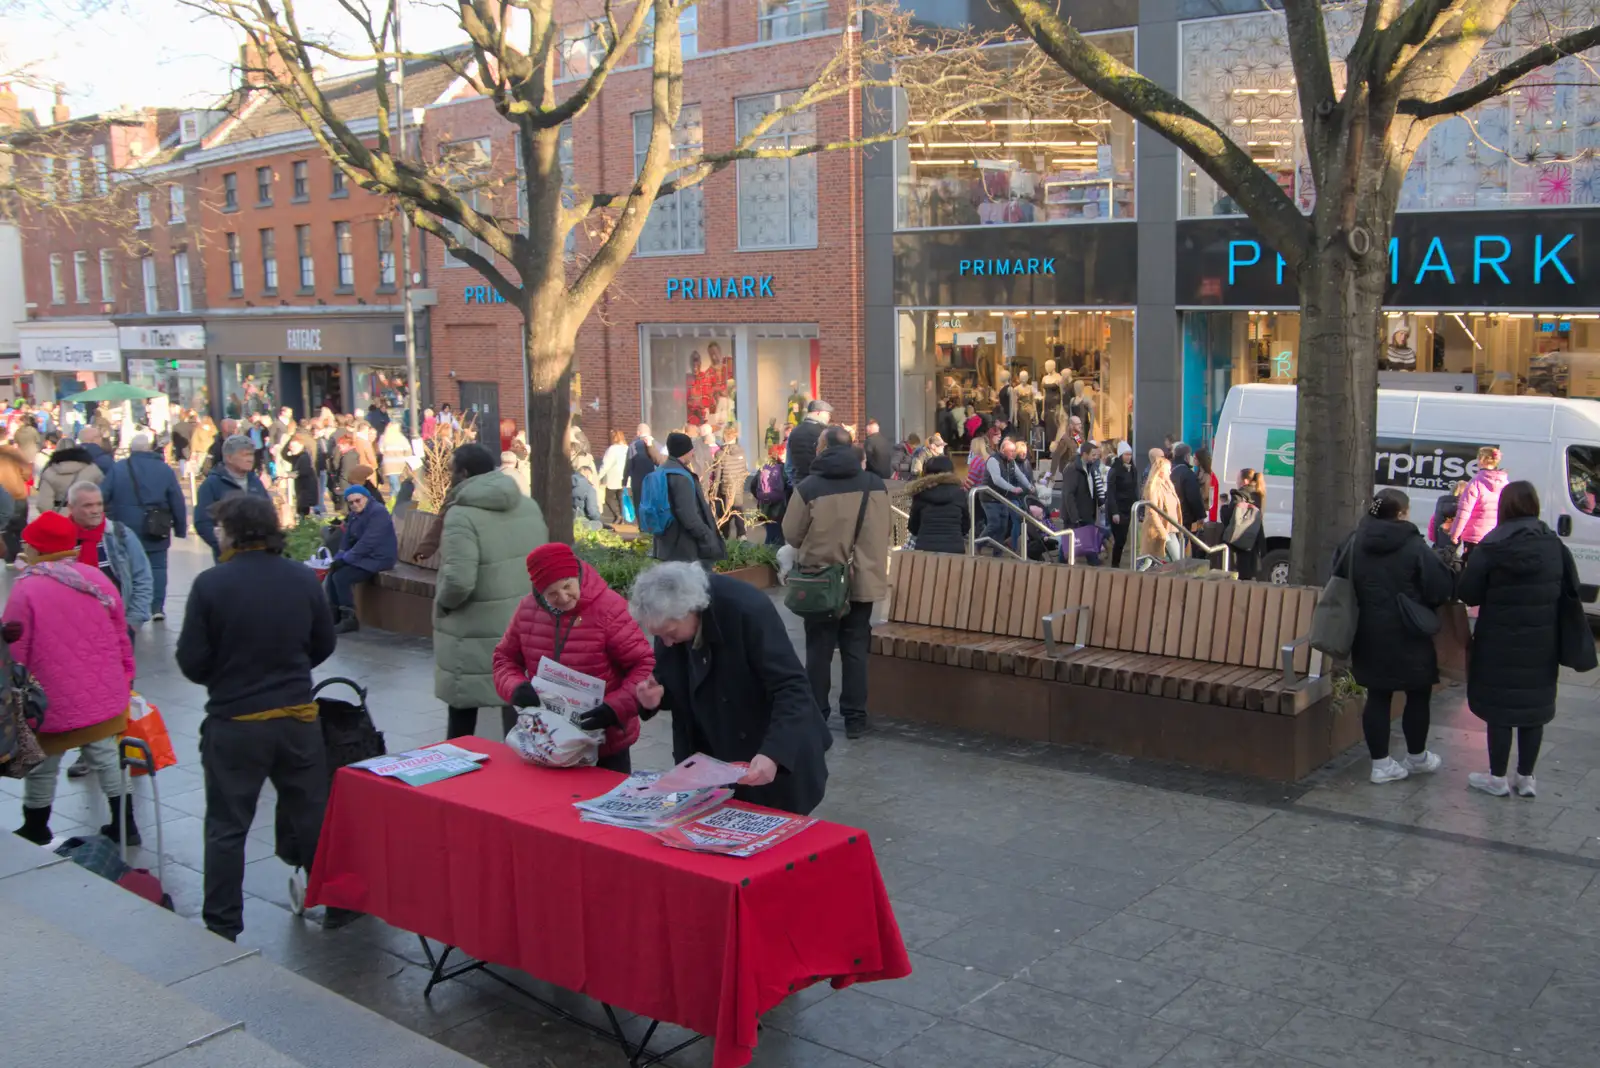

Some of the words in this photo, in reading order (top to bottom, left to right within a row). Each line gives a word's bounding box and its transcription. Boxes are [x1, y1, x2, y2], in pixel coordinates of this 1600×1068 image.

[959, 257, 1057, 276] PRIMARK
[1228, 233, 1576, 285] PARK
[666, 275, 776, 299] PRIMARK
[36, 345, 63, 365] Optical
[1375, 449, 1479, 480] rprise
[1408, 475, 1456, 490] rent-a
